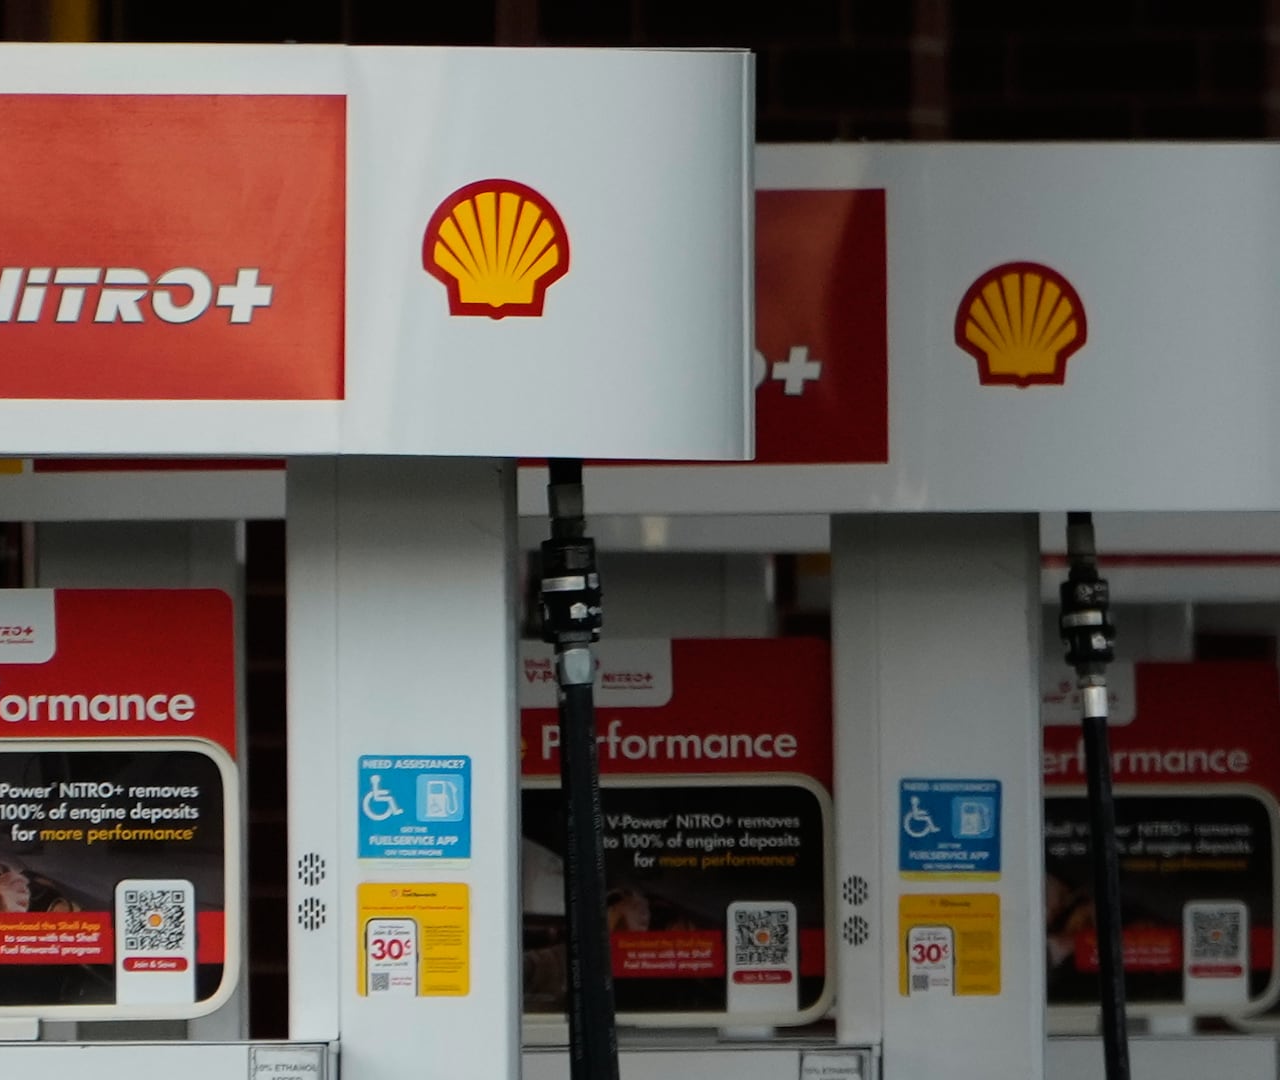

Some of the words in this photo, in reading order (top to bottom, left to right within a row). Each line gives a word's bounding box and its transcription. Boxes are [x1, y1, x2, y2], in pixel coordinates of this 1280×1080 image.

[128, 785, 199, 798] removes
[0, 804, 44, 820] 100%
[49, 803, 67, 820] of
[70, 805, 125, 823] engine
[130, 804, 199, 822] deposits
[738, 817, 800, 828] removes
[11, 824, 36, 842] for
[40, 827, 82, 840] more
[622, 834, 663, 848] 100%
[667, 833, 682, 848] of
[686, 833, 735, 852] engine
[739, 832, 800, 852] deposits
[634, 853, 656, 867] for
[658, 856, 697, 867] more
[0, 945, 18, 955] Fuel
